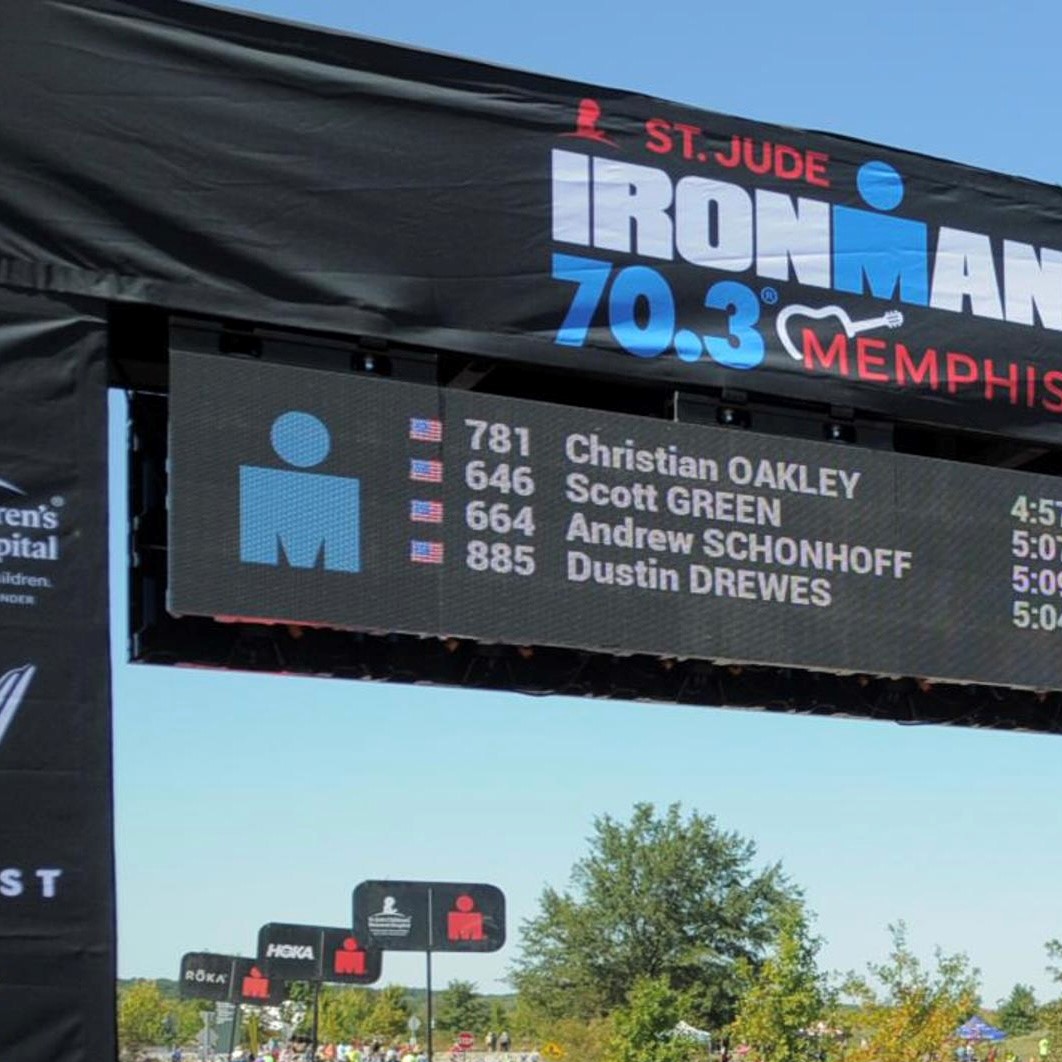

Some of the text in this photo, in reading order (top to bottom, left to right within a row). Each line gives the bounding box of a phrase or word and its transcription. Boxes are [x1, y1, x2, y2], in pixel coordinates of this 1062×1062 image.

[645, 118, 831, 187] ST. JUDE
[551, 253, 767, 370] 70.3
[464, 418, 530, 457] 781
[565, 433, 719, 482] Christian
[728, 456, 861, 499] OAKLEY
[465, 460, 536, 497] 646
[565, 473, 658, 513] Scott
[667, 486, 782, 527] GREEN
[465, 500, 536, 537] 664
[565, 512, 695, 555] Andrew
[703, 528, 913, 579] SCHONHOFF
[466, 540, 536, 576] 885
[567, 551, 680, 592] Dustin
[690, 564, 833, 607] DREWES
[266, 943, 315, 960] HOKA
